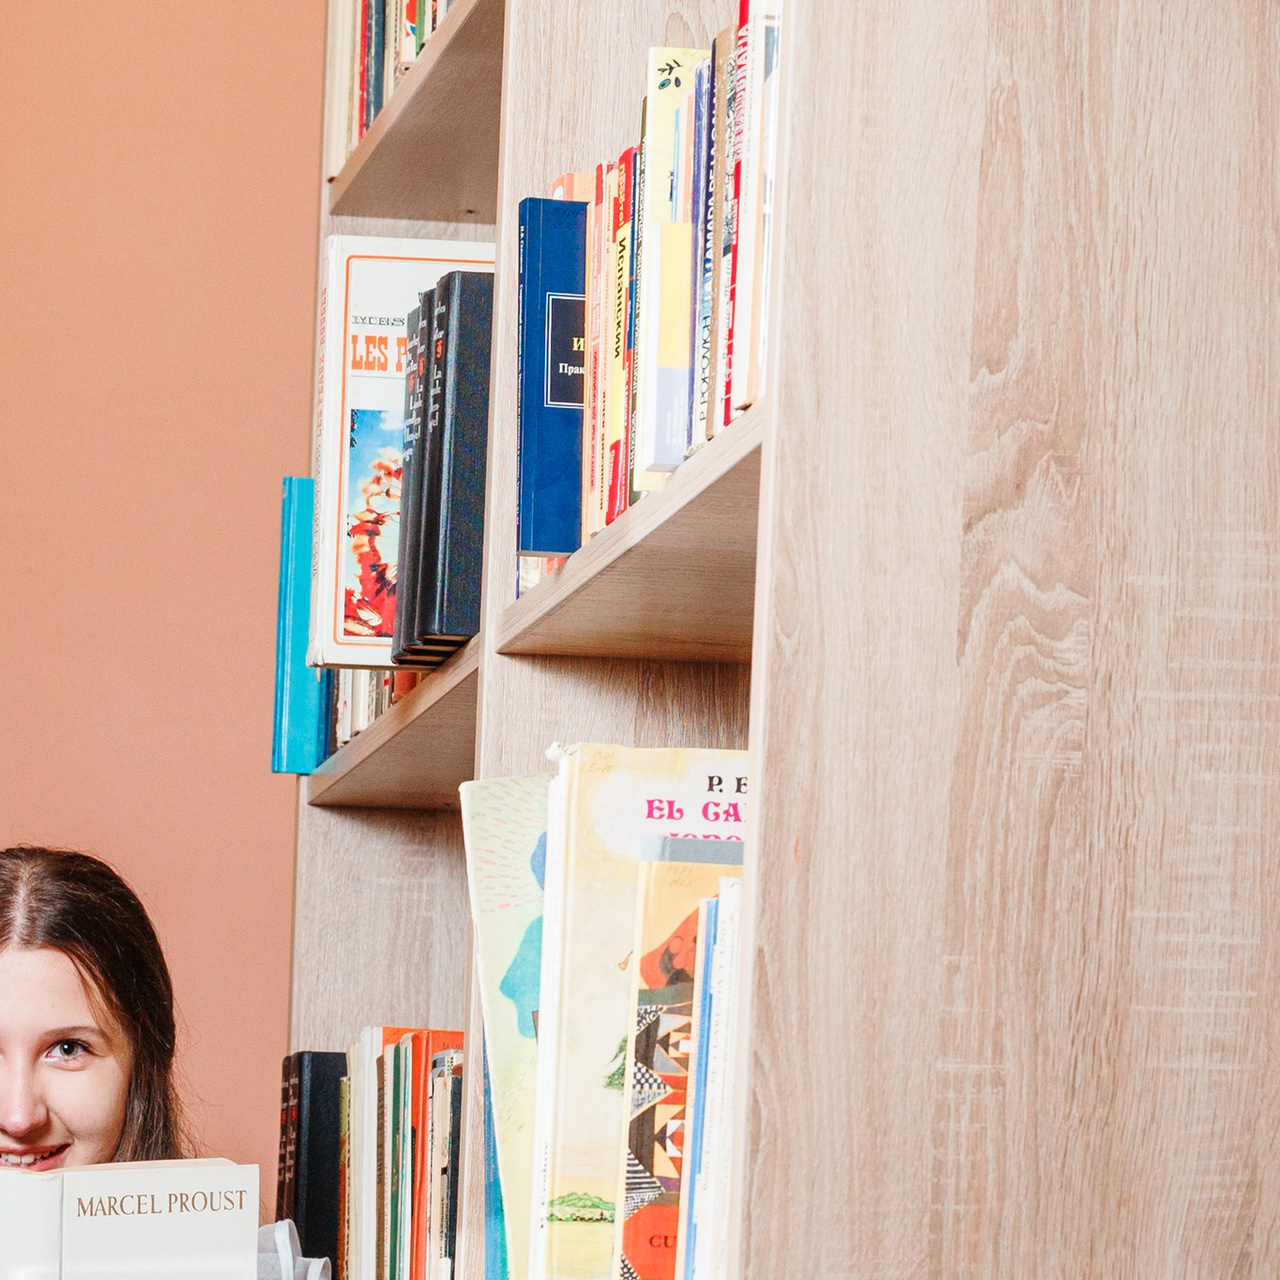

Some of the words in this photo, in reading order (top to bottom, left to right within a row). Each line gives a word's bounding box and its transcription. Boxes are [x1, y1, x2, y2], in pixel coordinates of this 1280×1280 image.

[613, 236, 627, 359] Испанский
[351, 334, 389, 372] LES
[707, 775, 724, 794] P.
[645, 798, 685, 821] EL
[76, 1194, 162, 1218] MARCEL
[167, 1190, 248, 1214] PROUST
